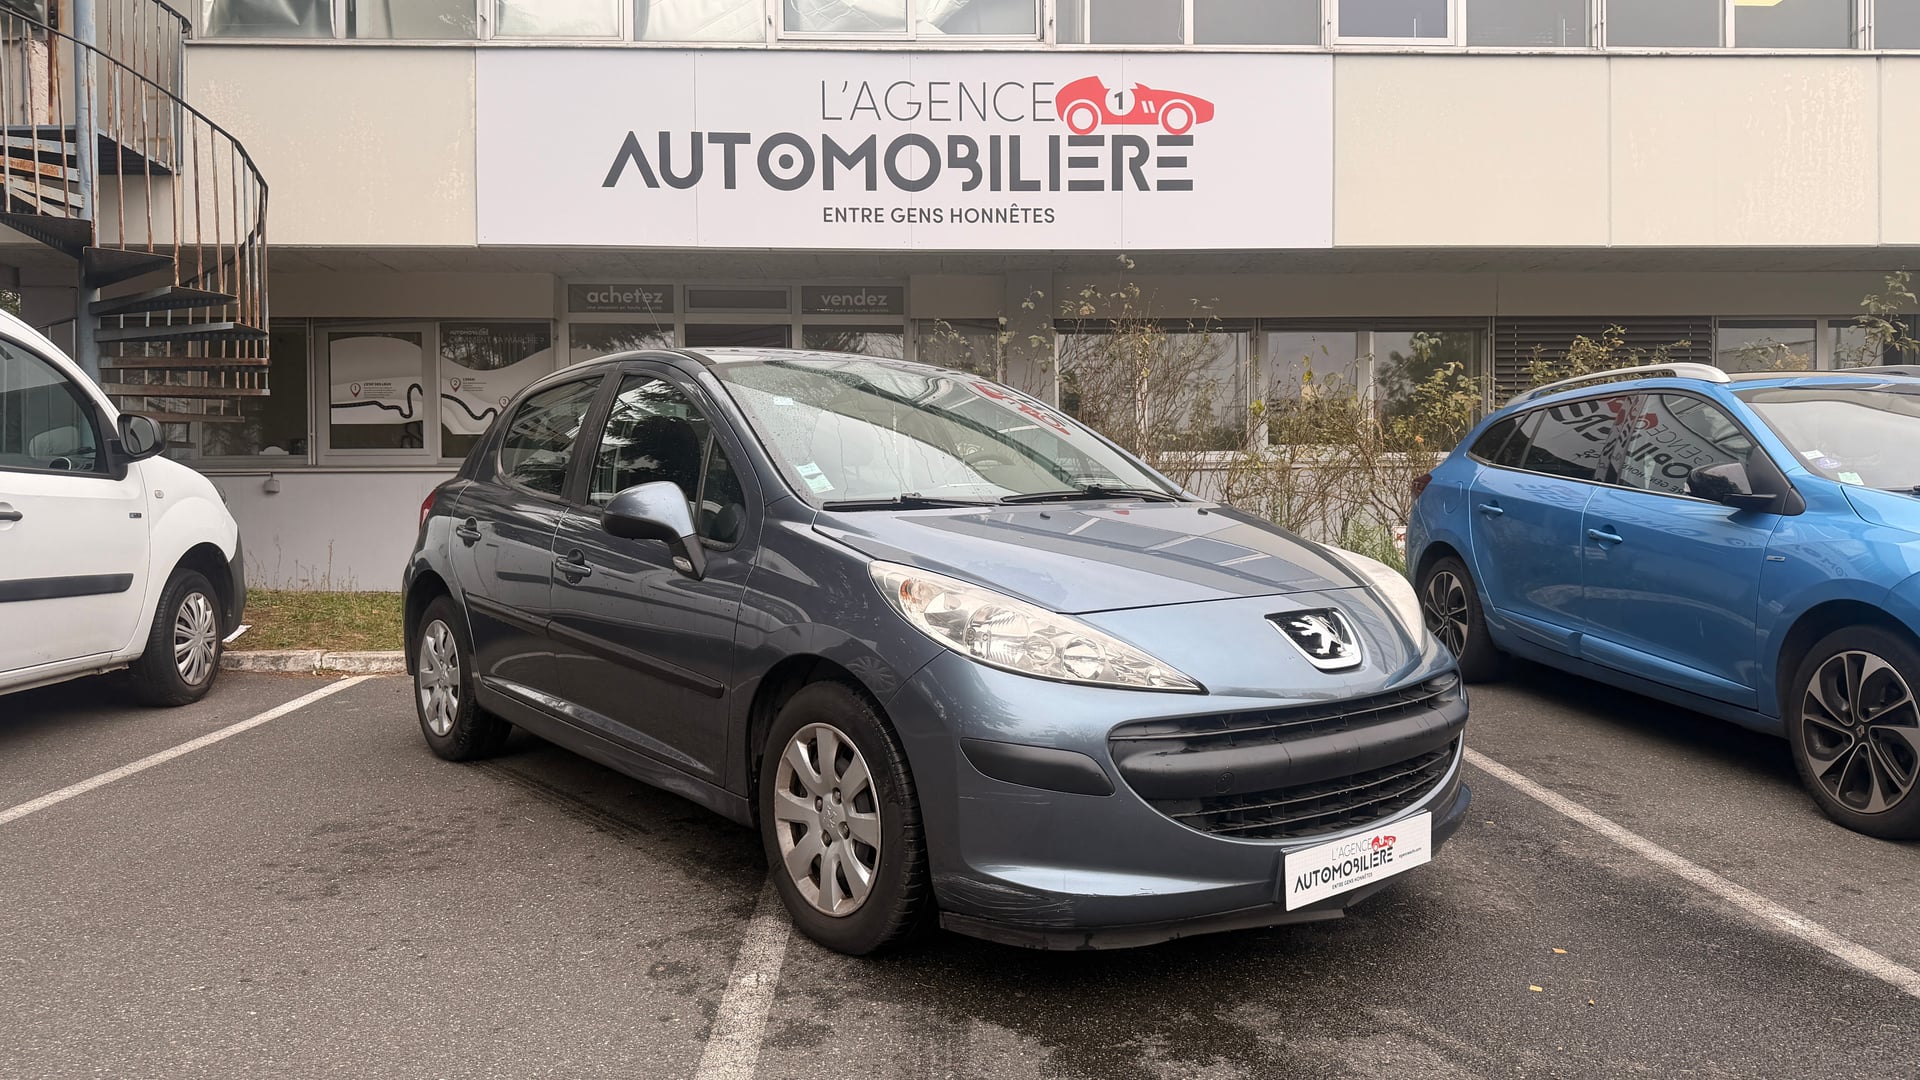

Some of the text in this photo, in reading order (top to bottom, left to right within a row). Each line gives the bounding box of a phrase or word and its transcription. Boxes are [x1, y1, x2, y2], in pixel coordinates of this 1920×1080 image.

[822, 80, 1055, 122] L'AGENCE
[1114, 91, 1124, 110] 1
[823, 203, 1055, 224] ENTRE GENS HONNÊTES
[586, 286, 664, 304] achetez
[821, 287, 889, 306] vendez
